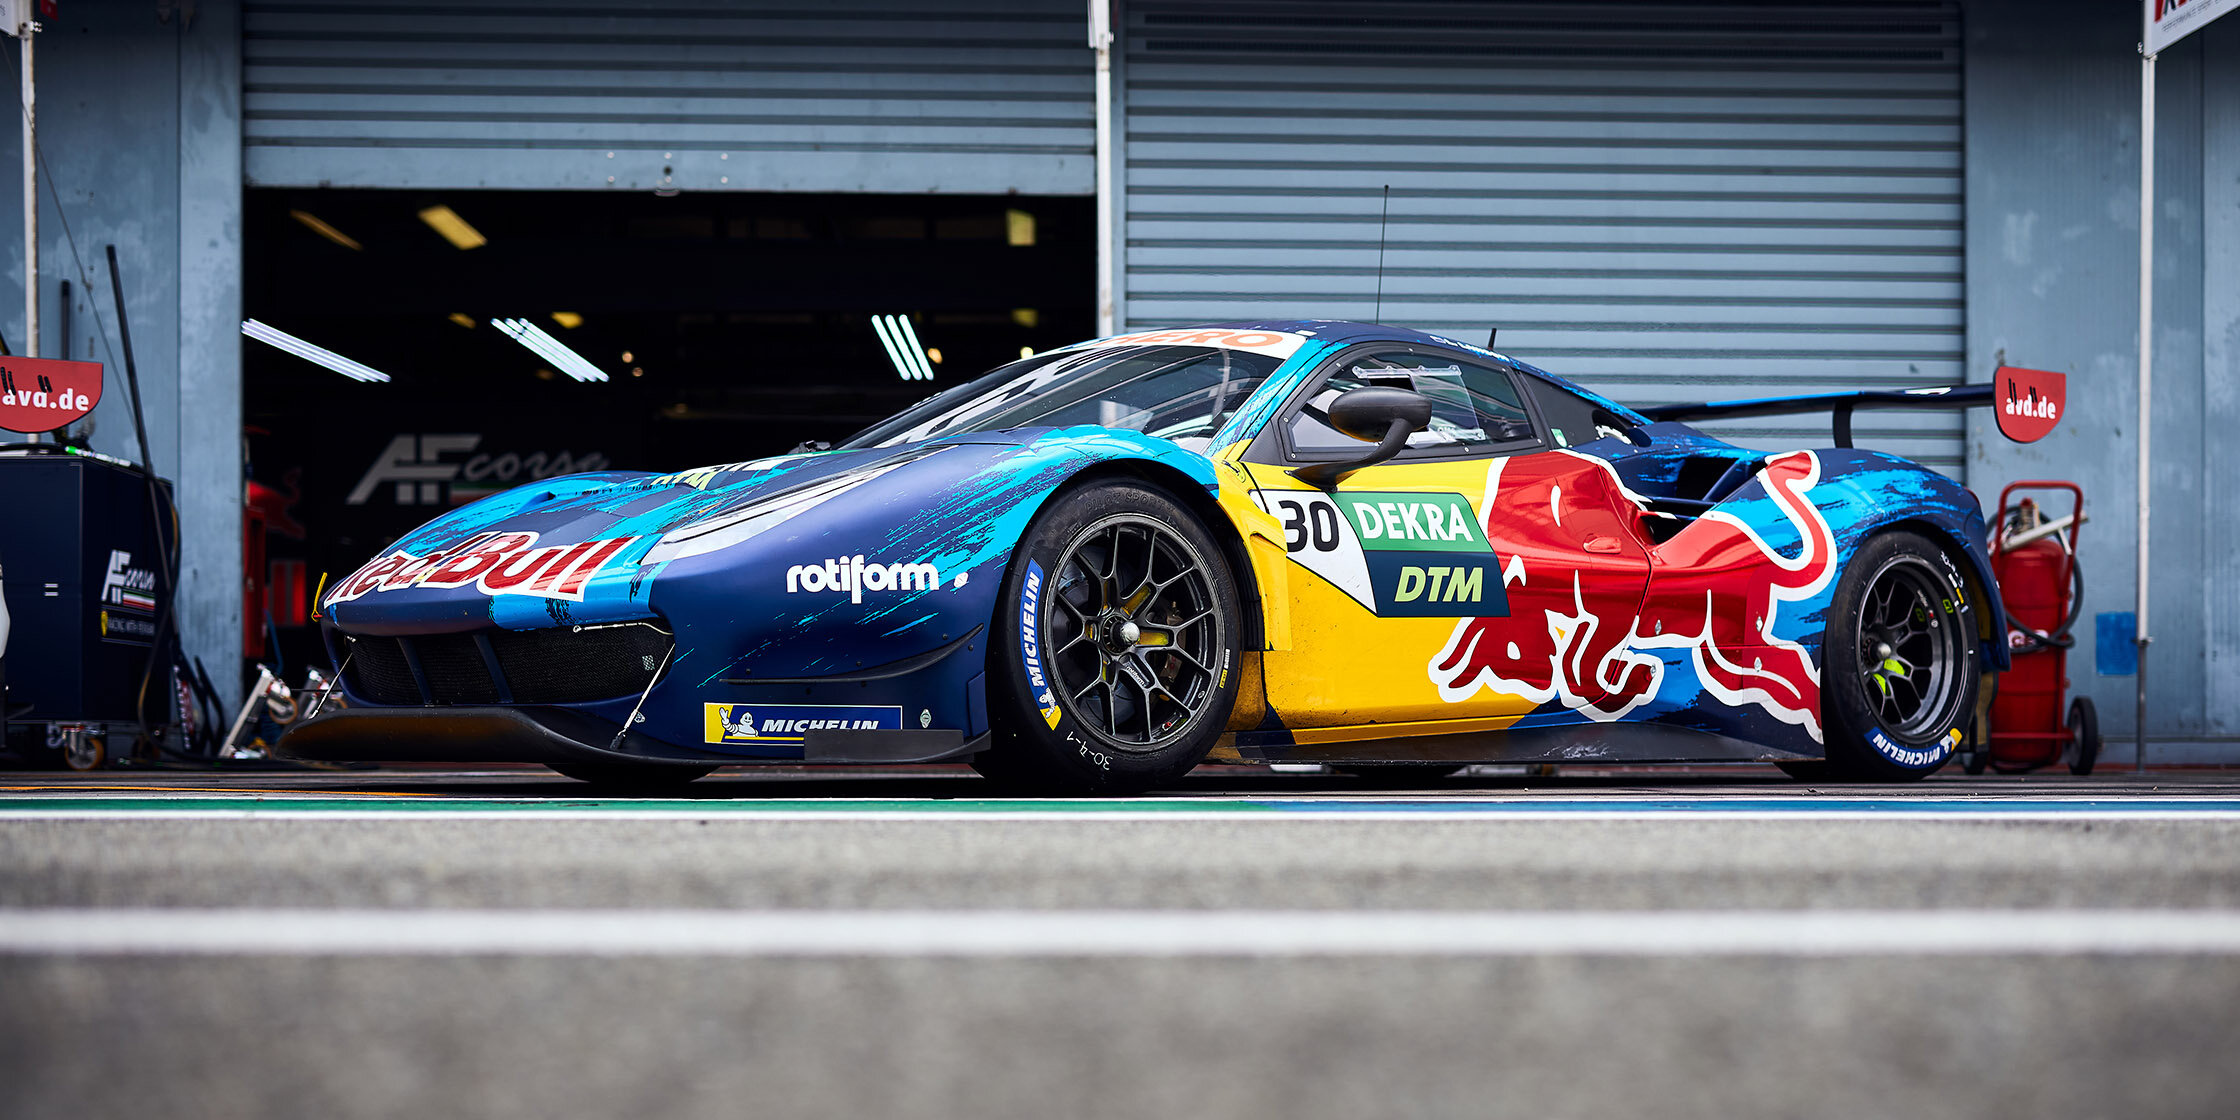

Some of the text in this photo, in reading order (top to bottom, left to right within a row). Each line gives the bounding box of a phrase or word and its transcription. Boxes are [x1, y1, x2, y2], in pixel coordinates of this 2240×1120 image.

[2005, 394, 2056, 419] avd.de
[346, 434, 482, 505] AF
[1278, 500, 1340, 552] 30
[1352, 502, 1475, 542] DEKRA
[417, 531, 642, 602] Bull
[786, 554, 940, 605] rotiform
[1394, 566, 1483, 603] DTM
[1021, 570, 1046, 688] MICHELIN
[762, 719, 880, 733] MICHELIN
[1066, 731, 1114, 771] 30-4-1
[1873, 732, 1941, 765] MICHELIN
